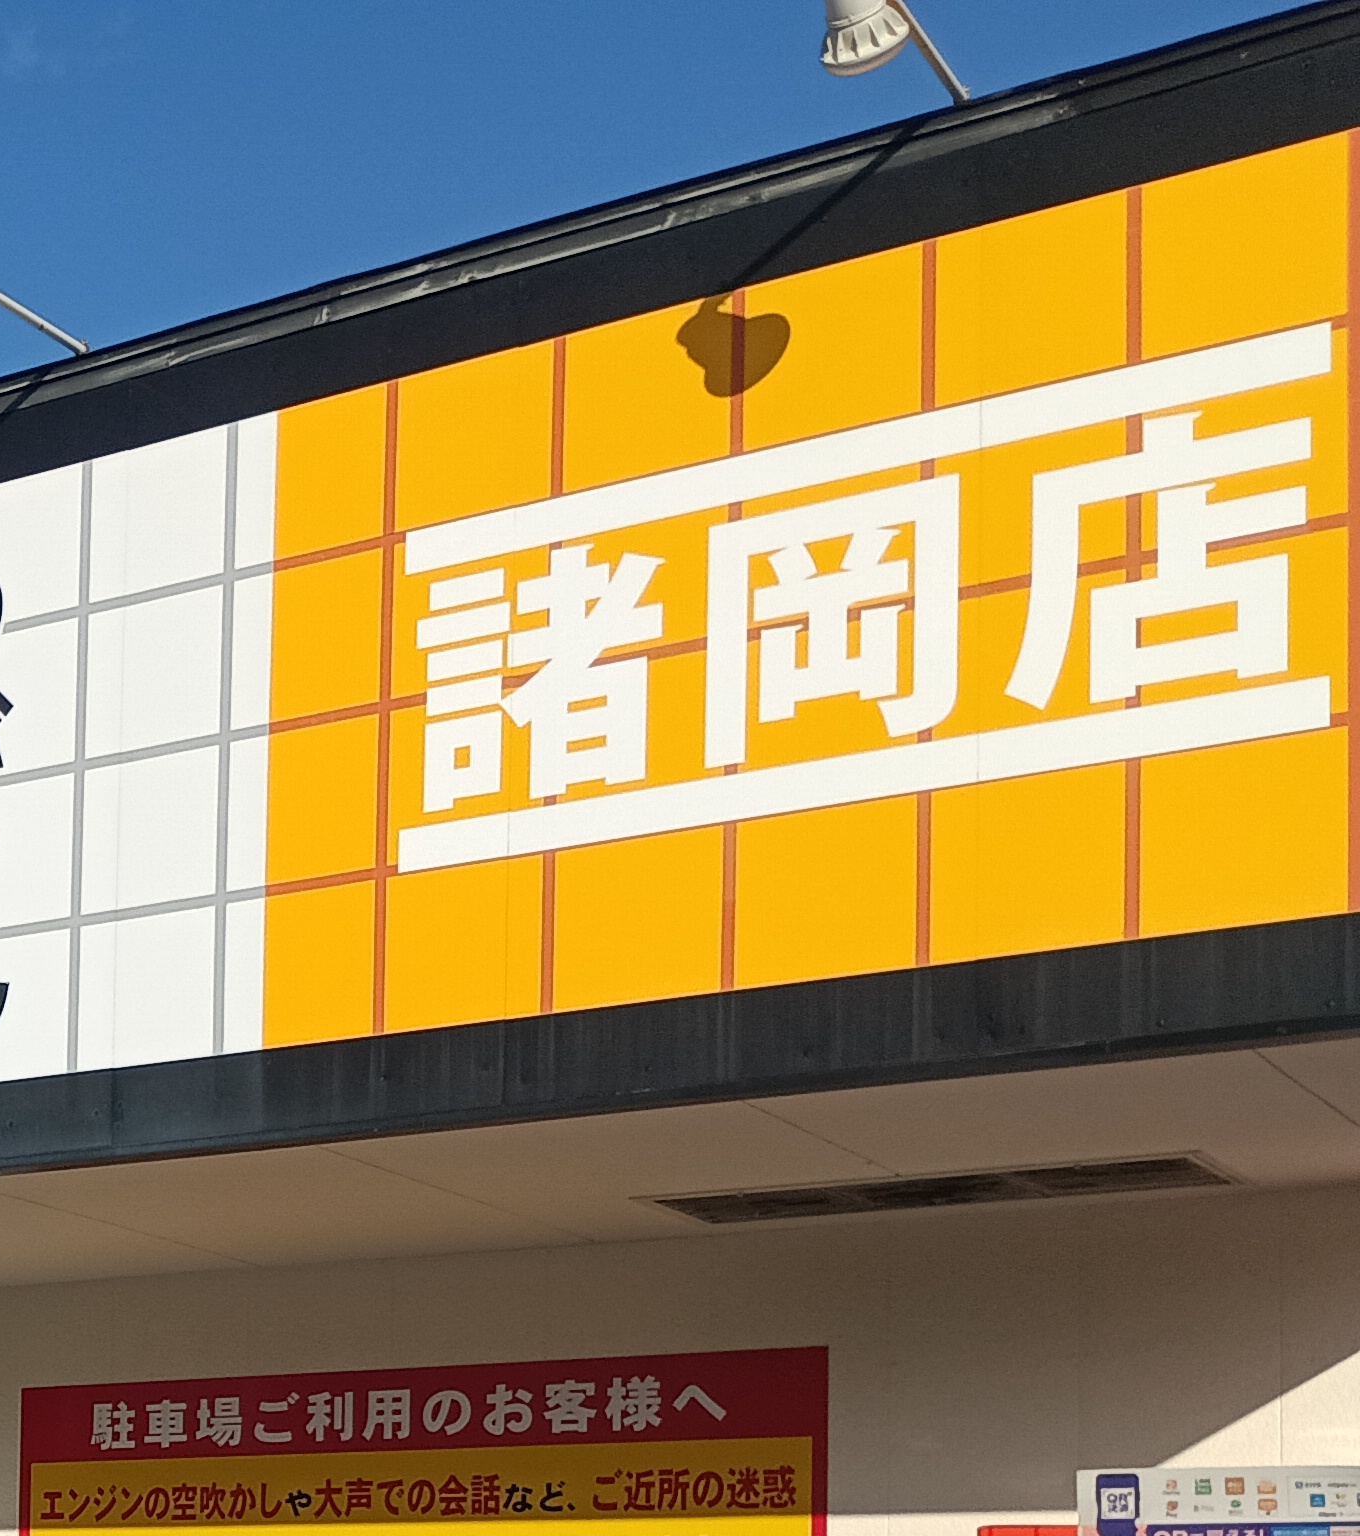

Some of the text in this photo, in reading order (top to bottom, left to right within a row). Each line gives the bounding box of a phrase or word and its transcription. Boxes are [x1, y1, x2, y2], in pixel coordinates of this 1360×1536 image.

[415, 411, 1312, 814] 諸岡店
[90, 1374, 728, 1451] 駐車場ご利用のお客様へ
